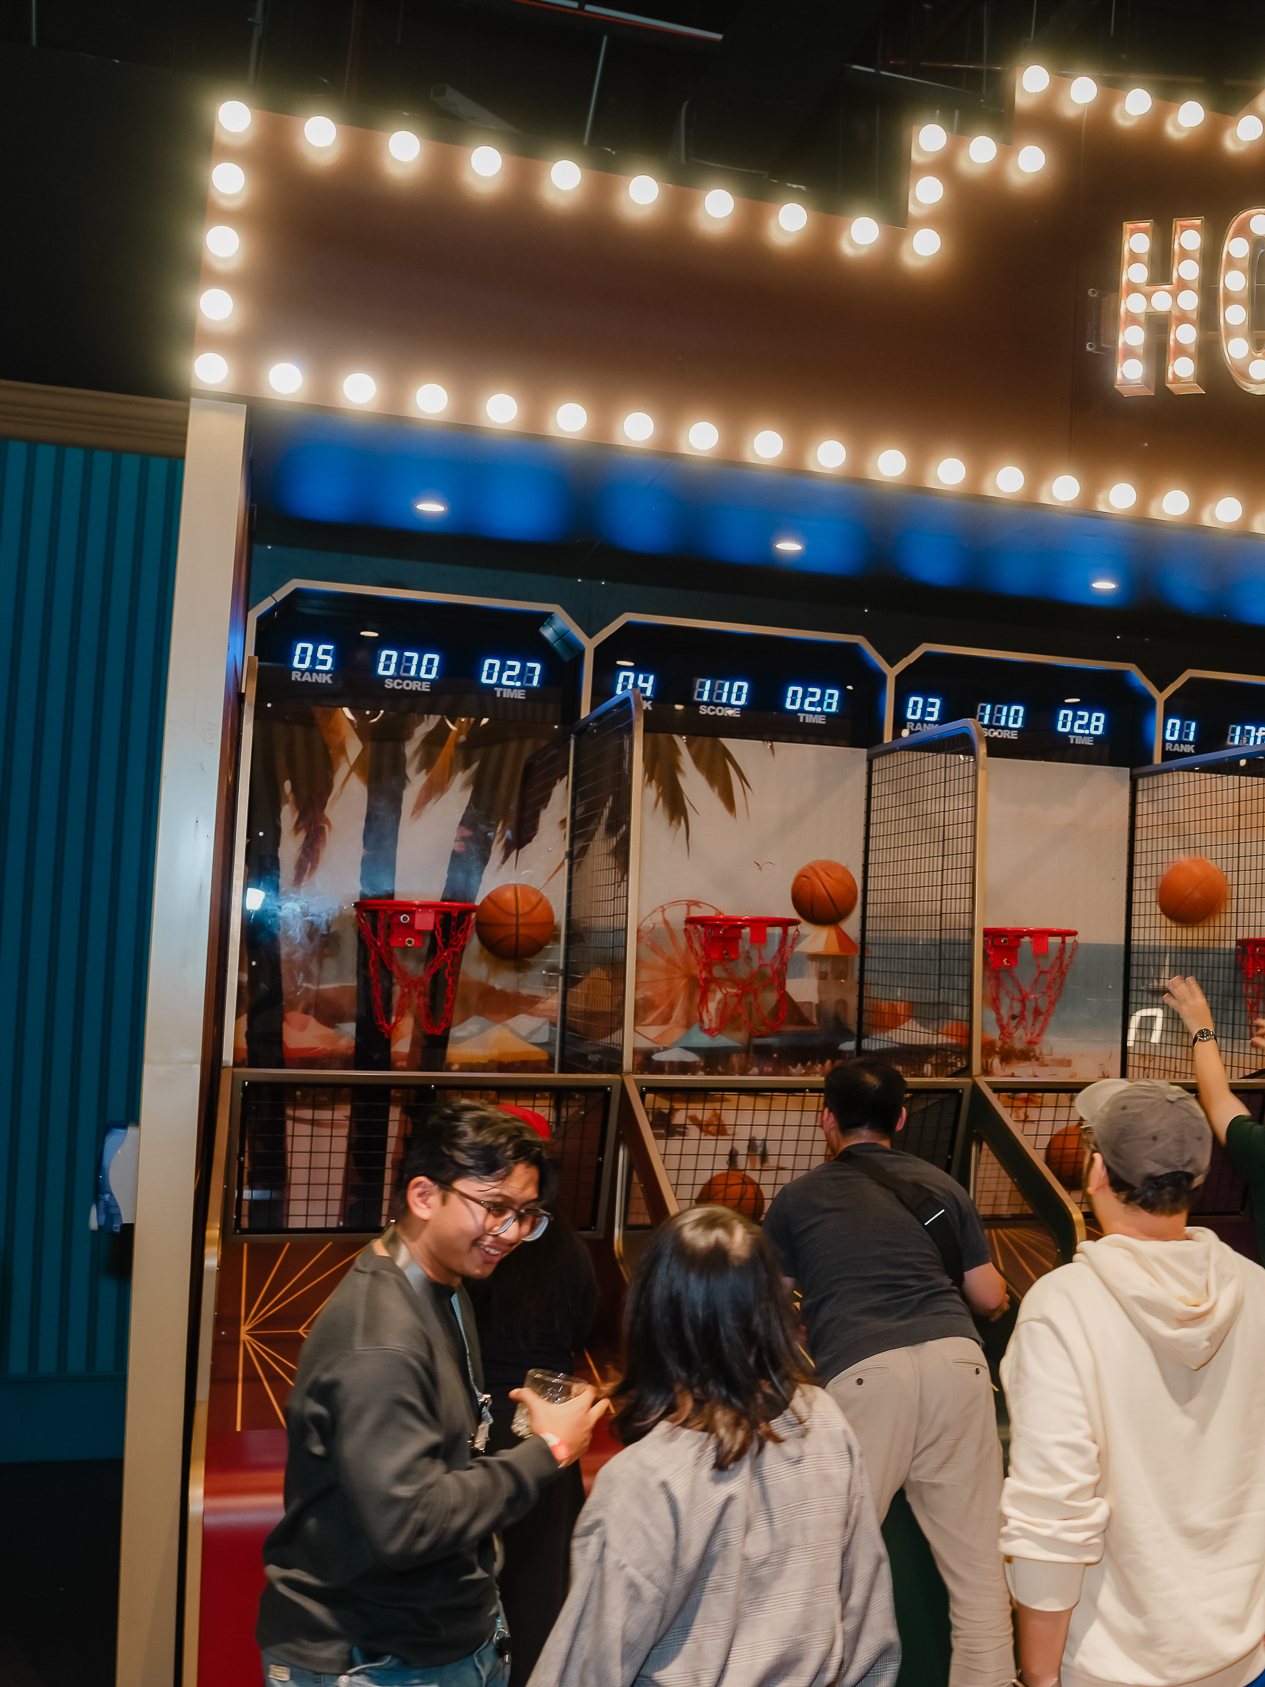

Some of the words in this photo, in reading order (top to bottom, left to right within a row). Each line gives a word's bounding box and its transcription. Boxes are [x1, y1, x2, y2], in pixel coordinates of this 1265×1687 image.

[292, 642, 335, 671] 05
[377, 650, 441, 679] 070
[291, 671, 333, 684] RANK
[615, 671, 655, 697] 04
[384, 678, 431, 692] SCORE
[494, 687, 526, 699] TIME
[702, 679, 749, 706] 110
[698, 705, 741, 718] SCORE
[906, 696, 941, 722] 03
[982, 703, 1025, 729] 110
[797, 713, 826, 725] TIME
[982, 728, 1018, 740] SCORE
[1165, 718, 1197, 742] 01
[1068, 735, 1094, 746] TIME
[1165, 742, 1196, 754] RANK
